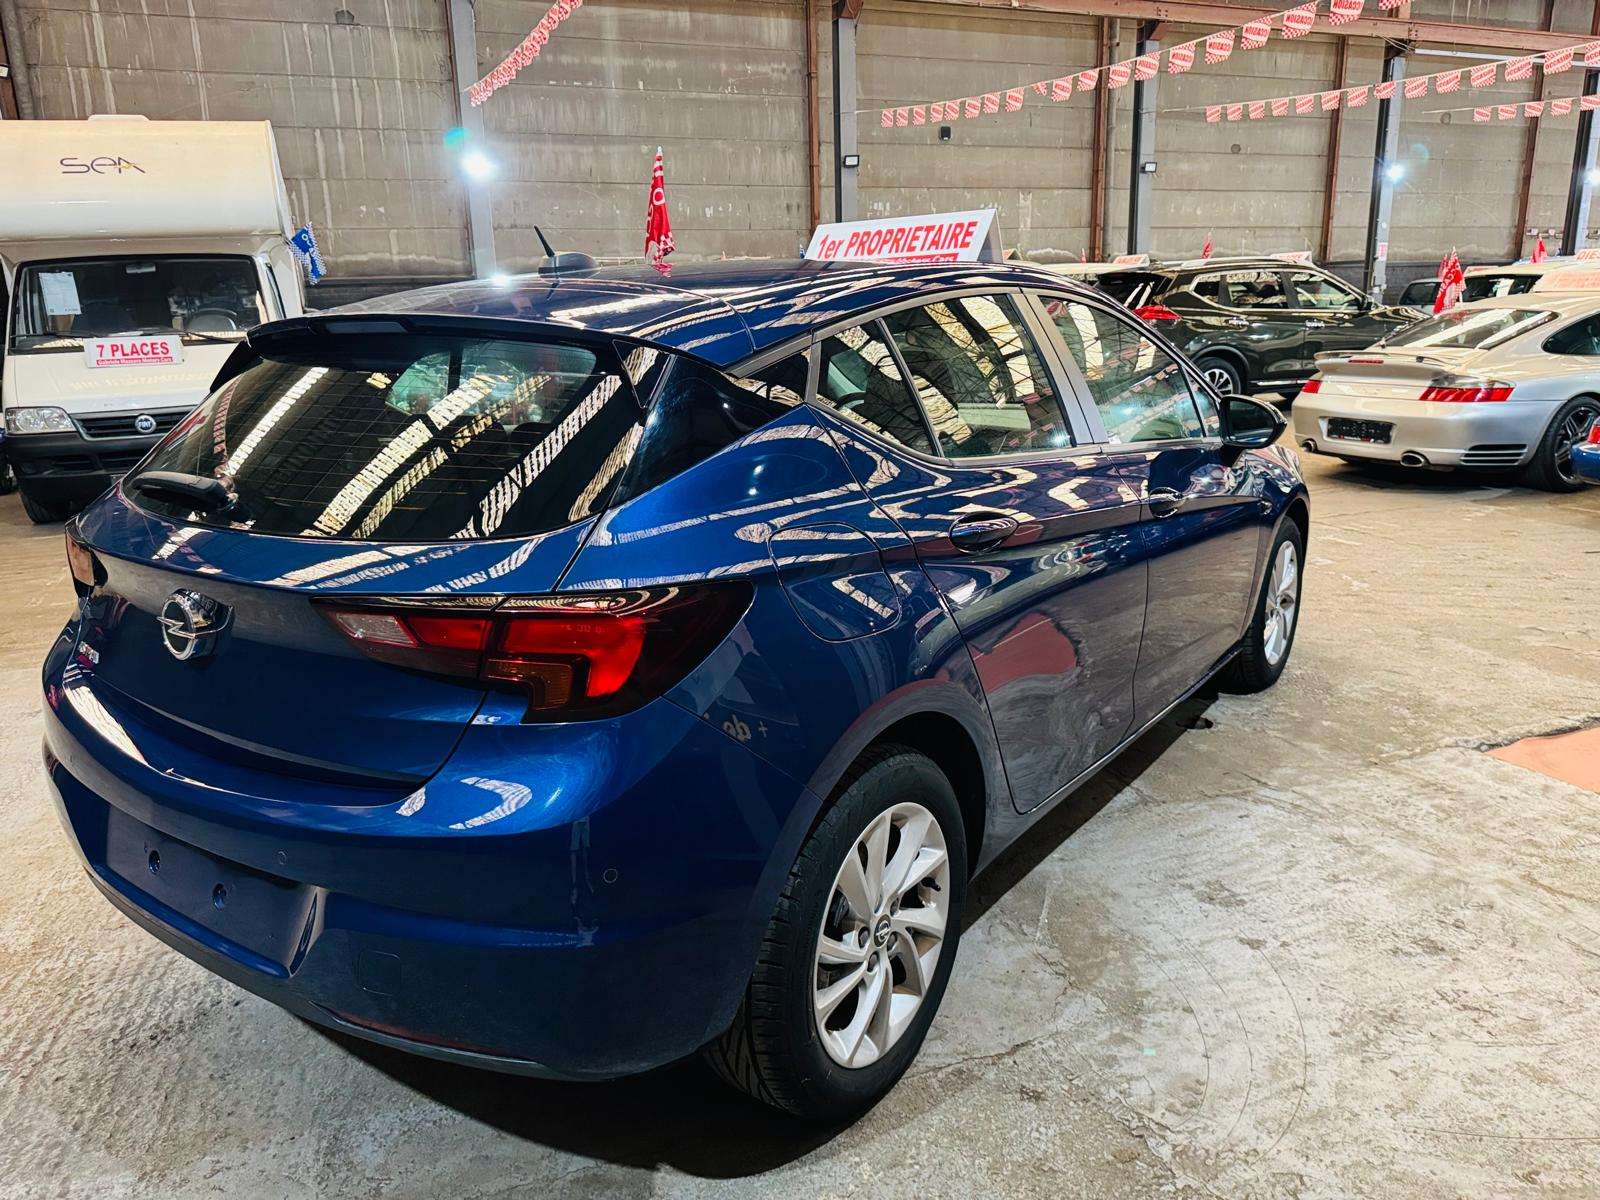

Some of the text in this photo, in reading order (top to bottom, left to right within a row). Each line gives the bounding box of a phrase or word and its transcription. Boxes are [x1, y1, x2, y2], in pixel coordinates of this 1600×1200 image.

[817, 220, 978, 259] 1er PROPRIETAIRE
[96, 341, 170, 358] 7 PLACES
